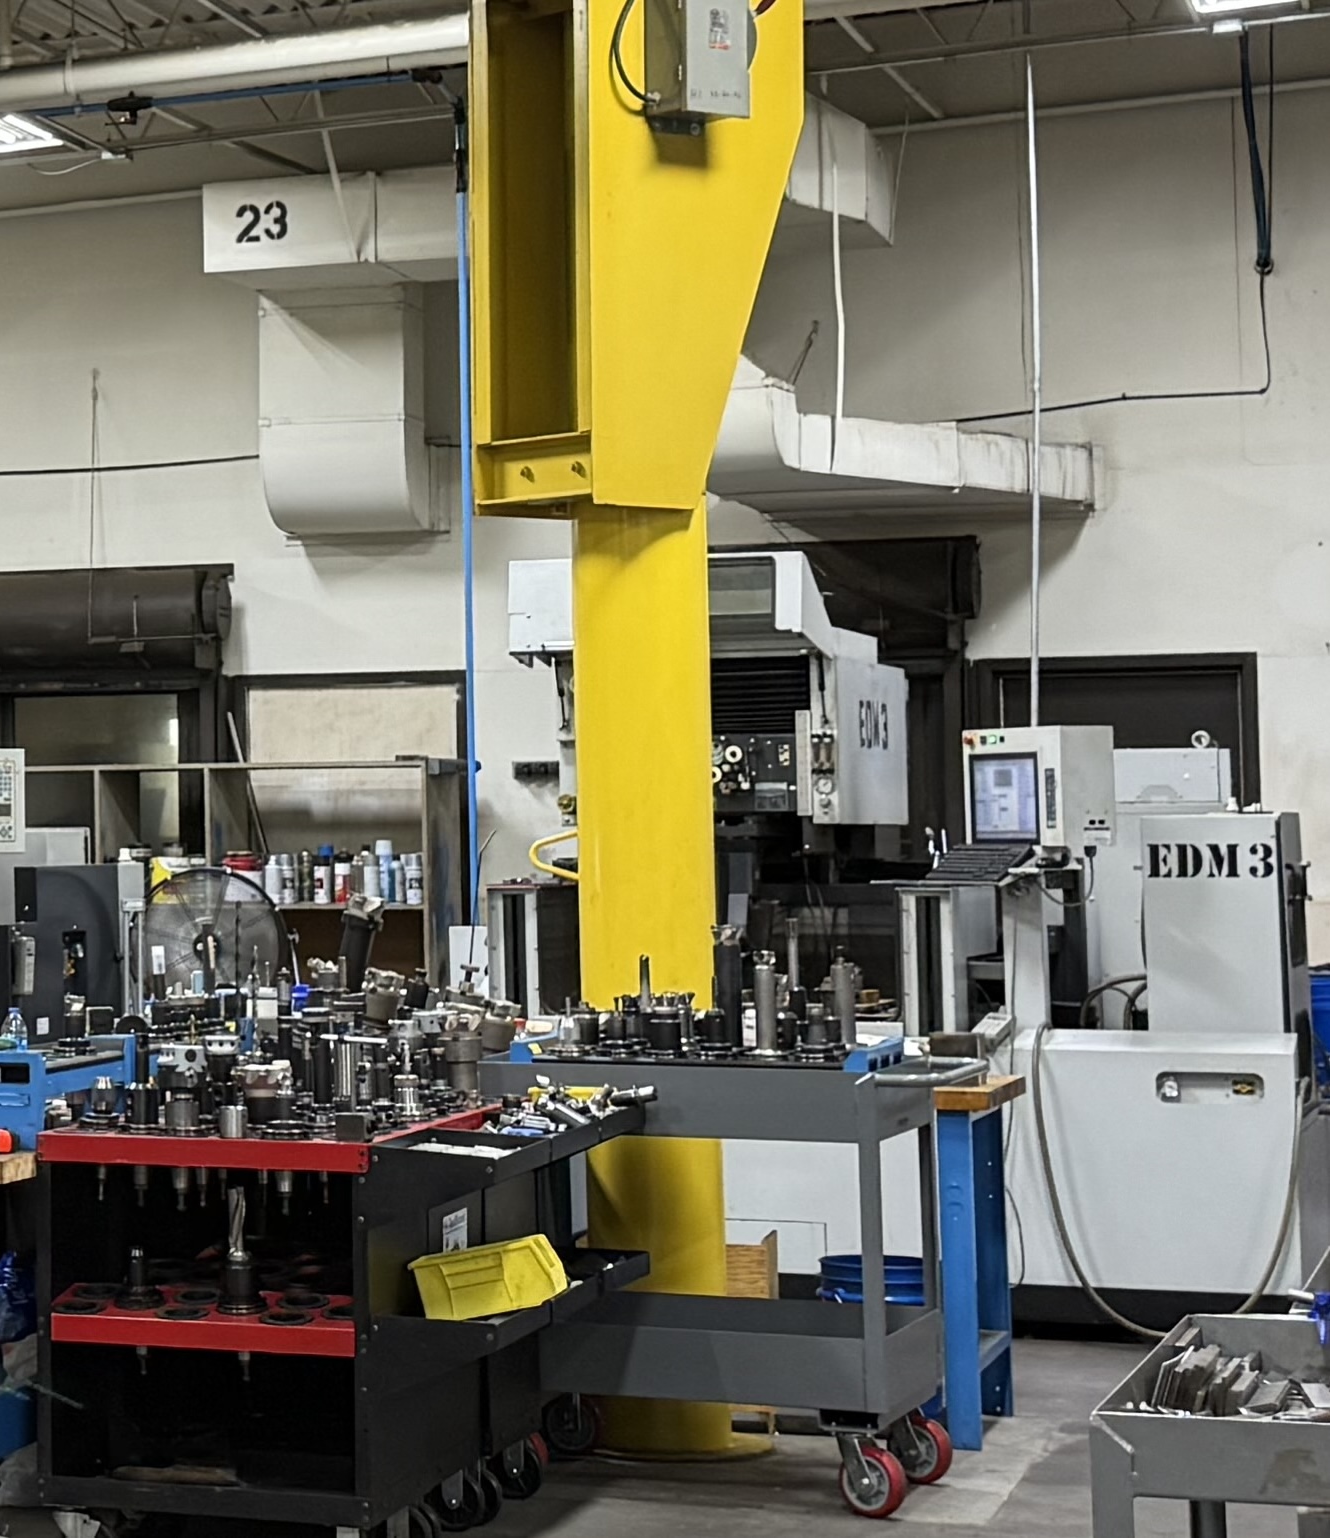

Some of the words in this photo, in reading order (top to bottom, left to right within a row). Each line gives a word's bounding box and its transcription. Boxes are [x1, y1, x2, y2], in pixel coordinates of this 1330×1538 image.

[235, 200, 288, 244] 23
[858, 699, 880, 749] EDM
[881, 703, 889, 751] 3
[1147, 843, 1240, 879] EDM
[1249, 843, 1274, 879] 3
